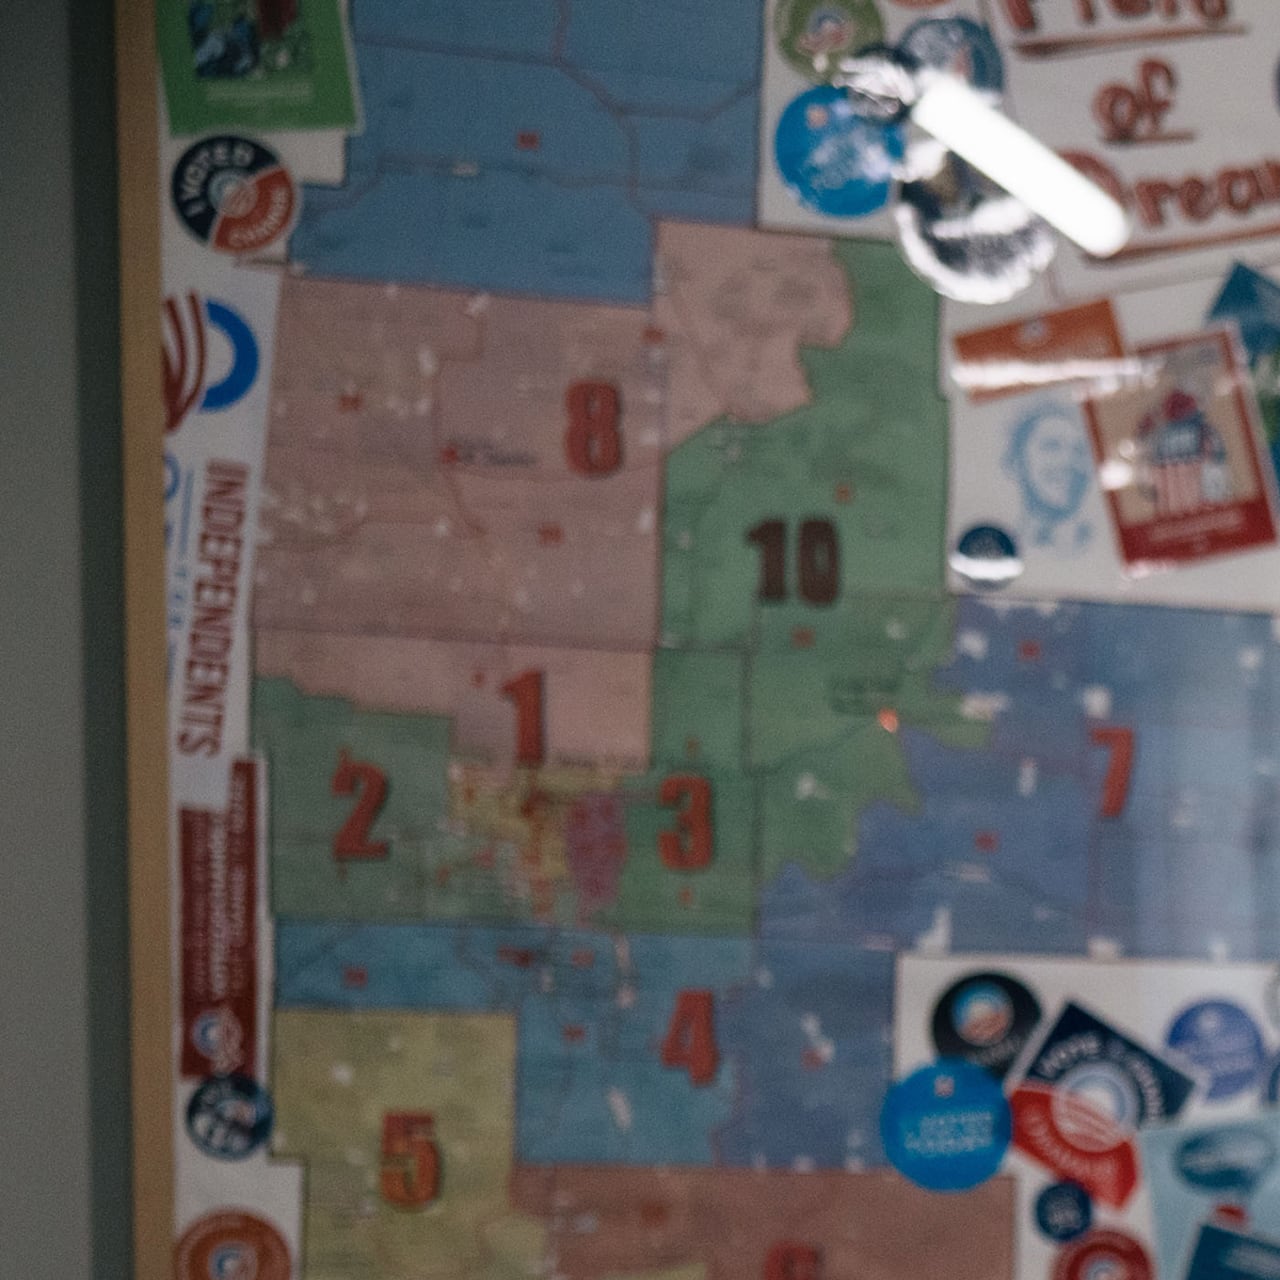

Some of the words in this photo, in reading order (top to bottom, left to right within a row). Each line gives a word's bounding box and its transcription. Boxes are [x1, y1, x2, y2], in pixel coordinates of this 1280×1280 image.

[1094, 60, 1177, 140] of
[564, 379, 623, 479] 8
[177, 459, 250, 758] INDEPENDENTS
[745, 518, 842, 608] 10
[502, 670, 547, 764] 1
[331, 760, 390, 861] 2
[1090, 726, 1136, 818] 7
[657, 775, 715, 872] 3
[660, 988, 721, 1087] 4
[380, 1111, 442, 1212] 5
